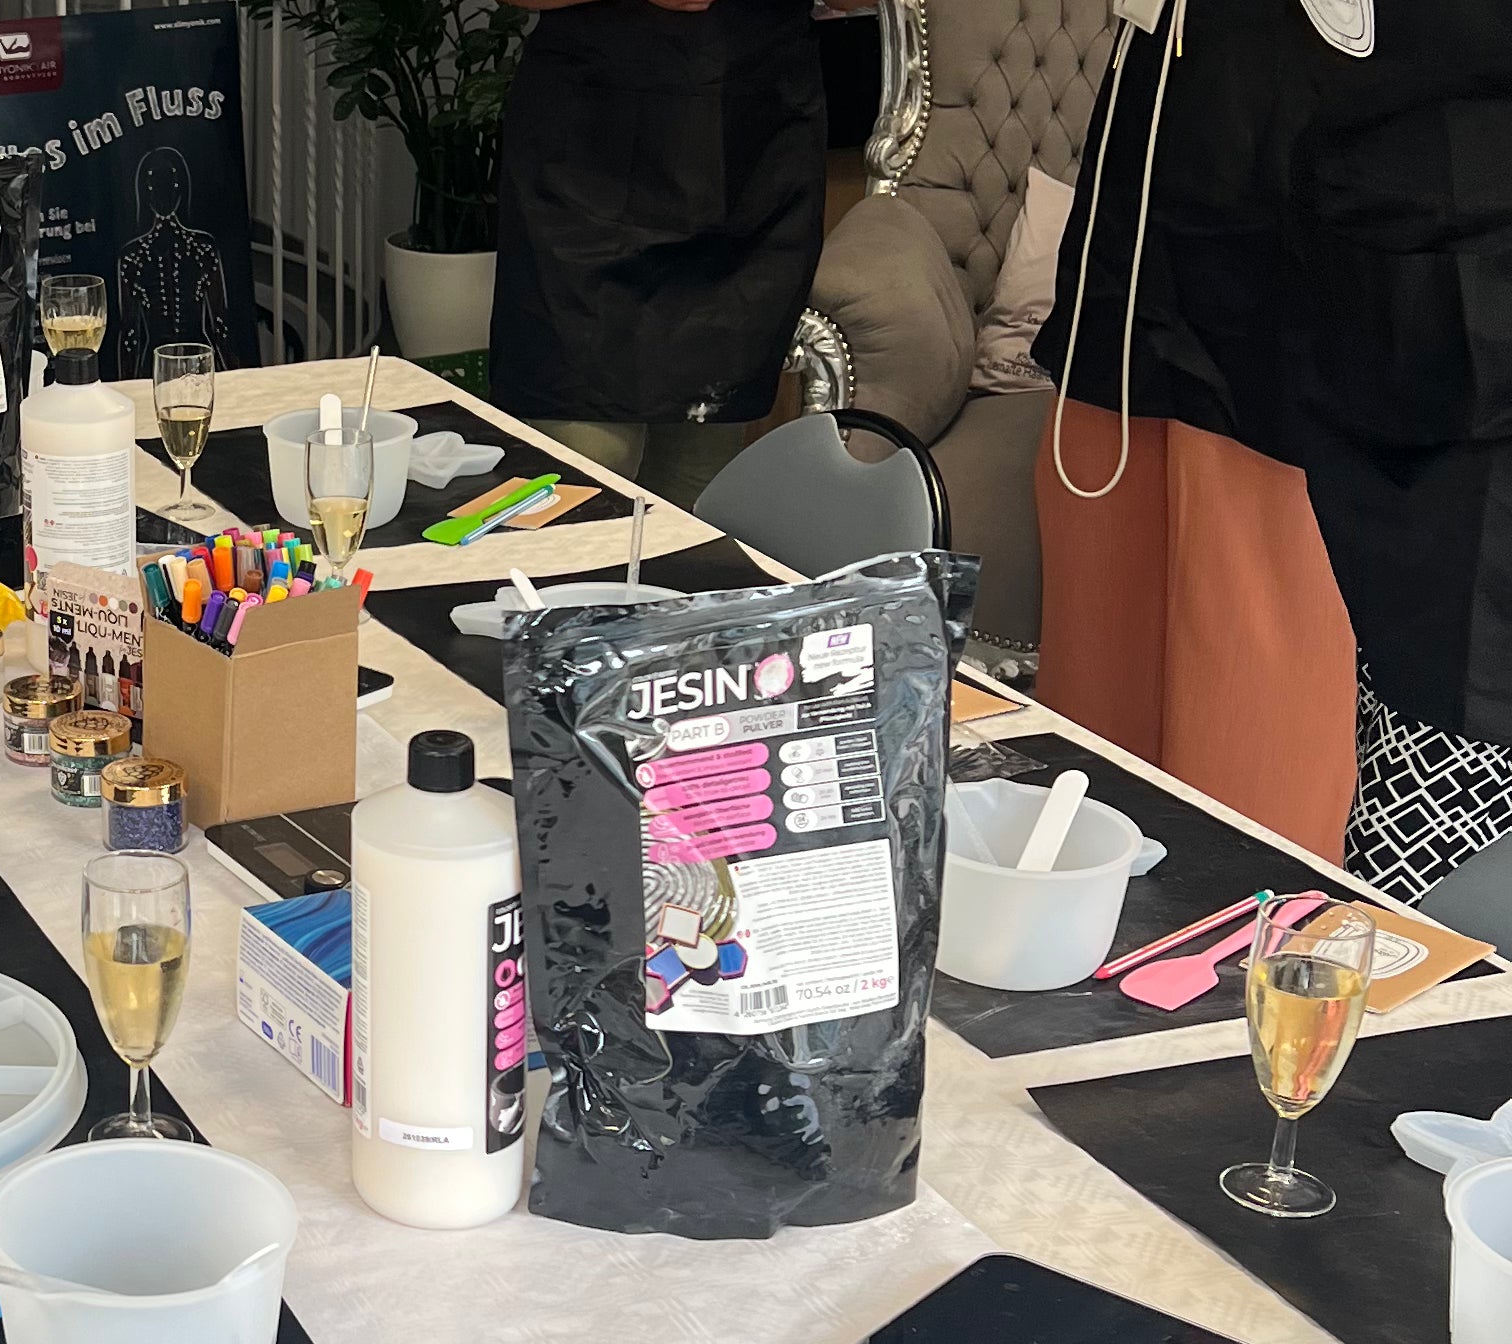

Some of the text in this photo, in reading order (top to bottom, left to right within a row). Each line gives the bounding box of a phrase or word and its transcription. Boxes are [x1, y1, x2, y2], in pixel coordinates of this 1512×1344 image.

[68, 112, 123, 155] im
[125, 86, 225, 128] Fluss
[77, 620, 143, 647] LIQU-MEN
[628, 664, 749, 720] JESIN
[739, 709, 786, 724] POWDER
[743, 719, 783, 734] PULVER
[671, 723, 726, 743] PART B
[796, 985, 832, 1001] 70.54
[835, 983, 850, 994] oz
[861, 979, 869, 990] 2
